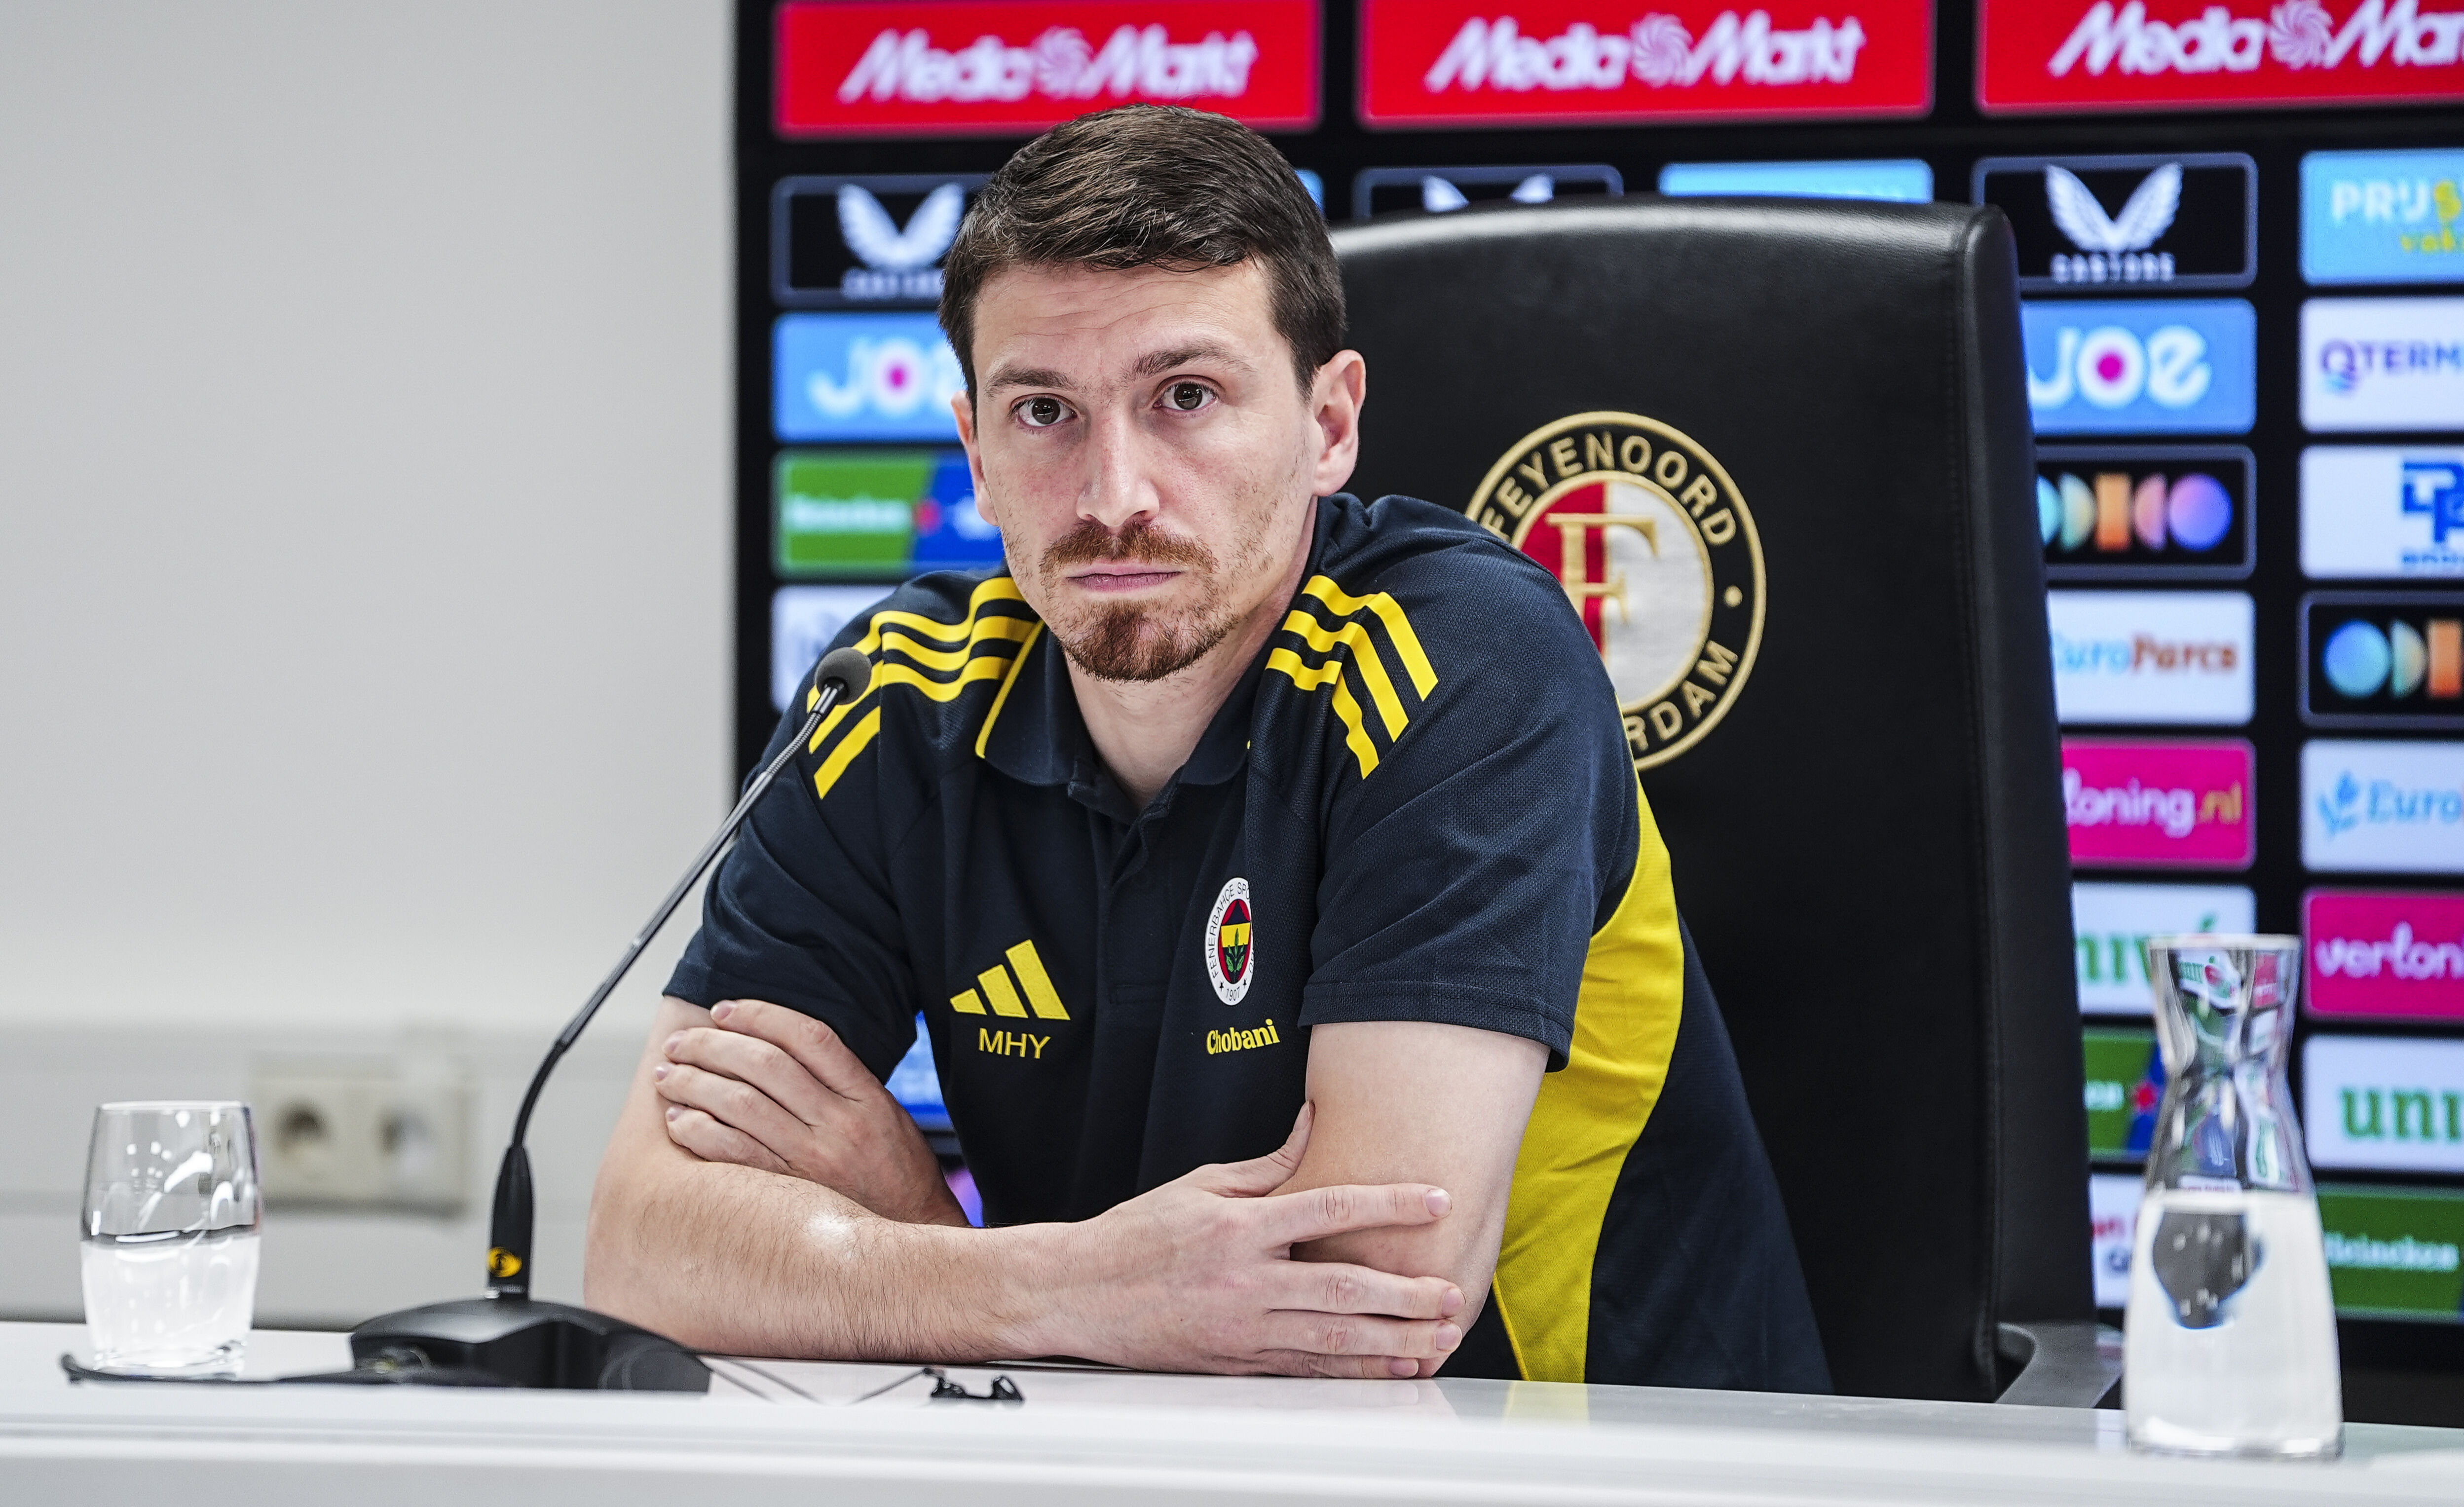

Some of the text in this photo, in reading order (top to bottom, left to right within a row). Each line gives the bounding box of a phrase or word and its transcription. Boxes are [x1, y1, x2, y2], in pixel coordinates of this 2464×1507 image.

[2318, 338, 2463, 395] QTERM
[1480, 430, 1737, 544] FEYENOORD
[2368, 779, 2463, 823] Euro
[1208, 881, 1251, 980] FENERBAHÇE SPO
[2314, 920, 2464, 978] verlon
[1225, 986, 1240, 1001] 1907
[978, 1027, 1051, 1059] MHY
[1206, 1018, 1280, 1055] Chobani
[2341, 1087, 2462, 1141] uni
